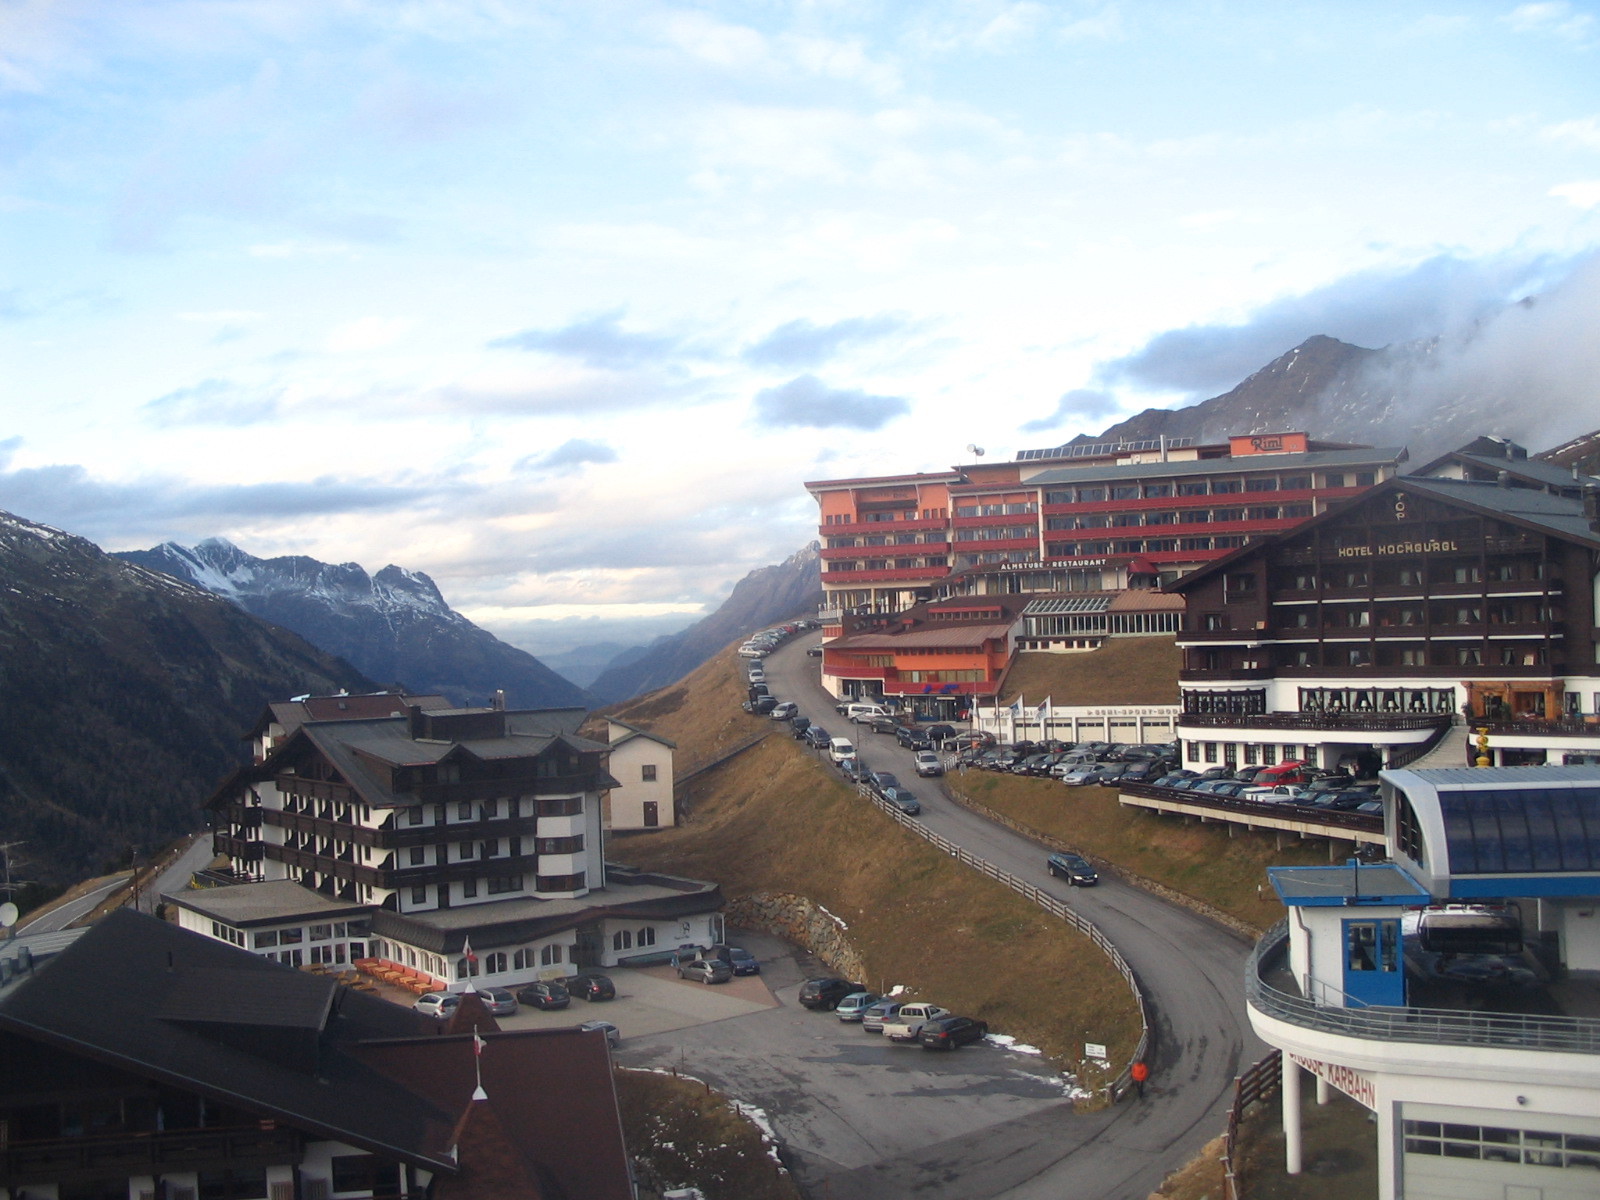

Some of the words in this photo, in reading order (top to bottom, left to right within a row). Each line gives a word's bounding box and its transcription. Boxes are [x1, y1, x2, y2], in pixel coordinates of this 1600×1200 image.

[1395, 492, 1405, 520] TOP
[1338, 546, 1373, 557] HOTEL
[1378, 541, 1458, 555] HOCHGURGL
[1001, 561, 1043, 570] ALMSTUBE
[1052, 559, 1106, 568] RESTAURANT
[1327, 1063, 1376, 1109] KARBAHN
